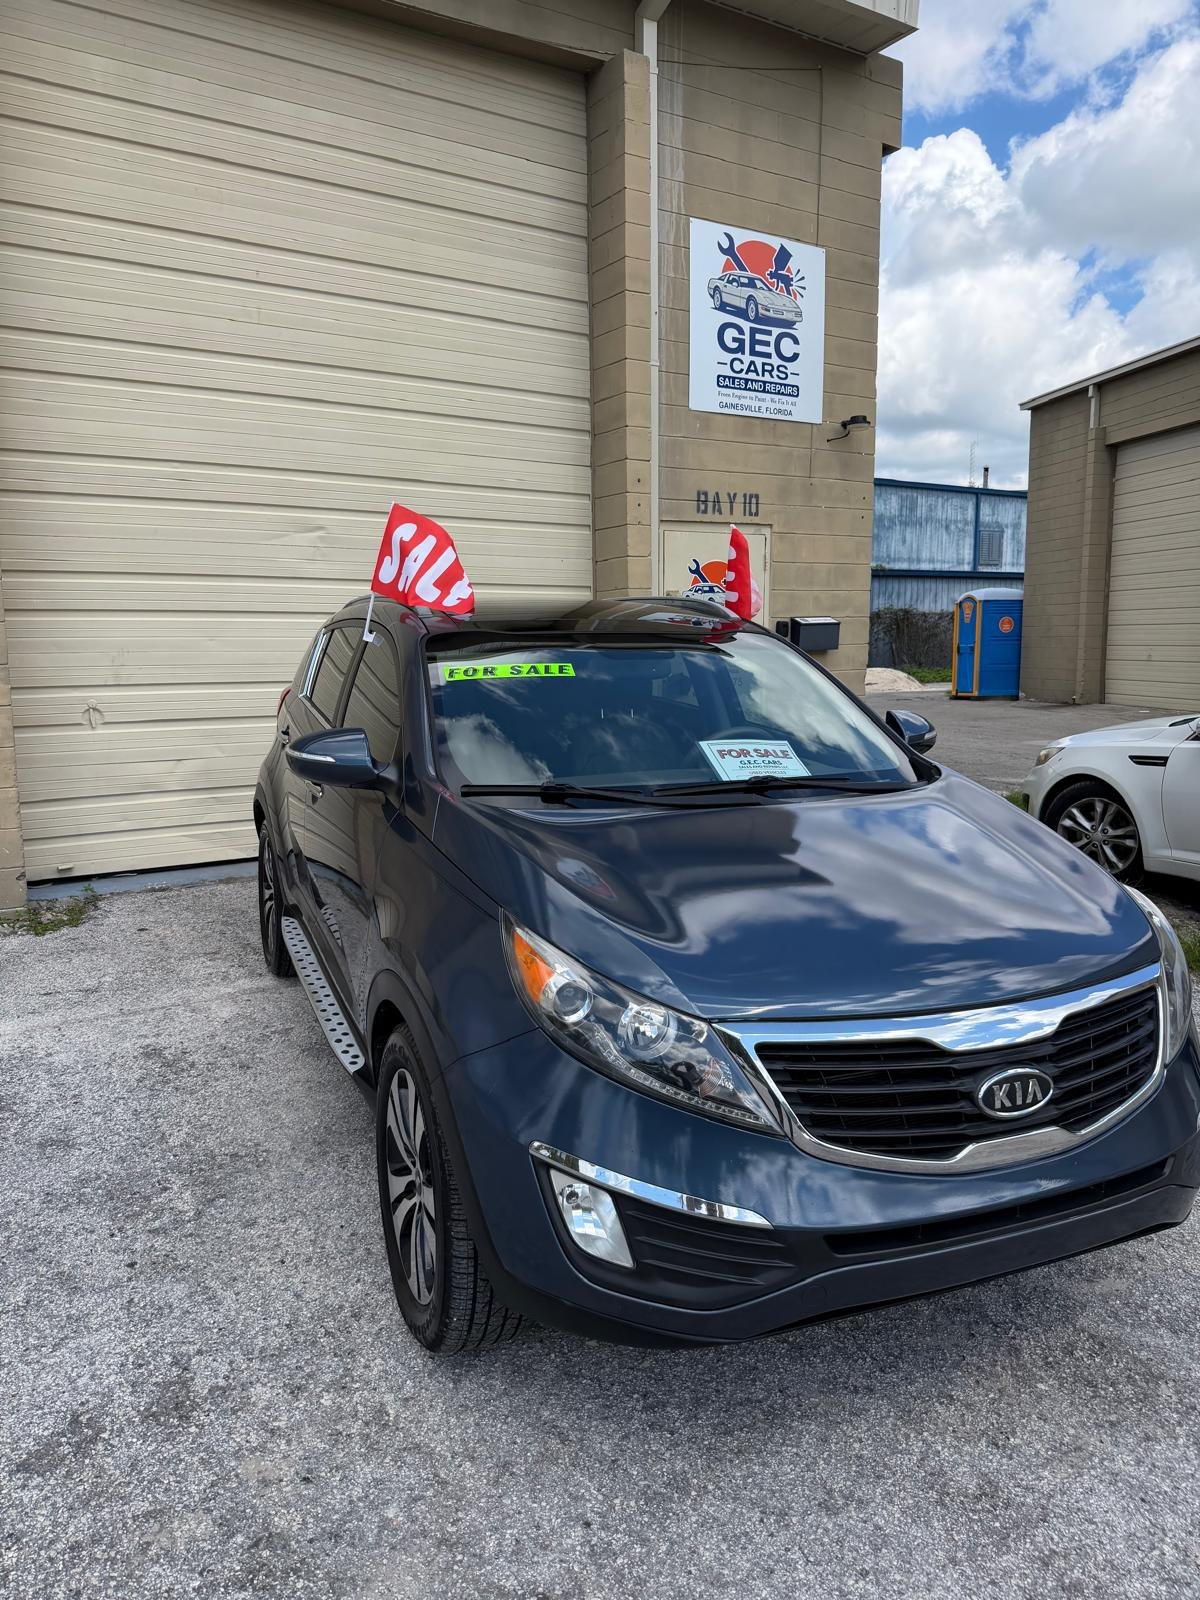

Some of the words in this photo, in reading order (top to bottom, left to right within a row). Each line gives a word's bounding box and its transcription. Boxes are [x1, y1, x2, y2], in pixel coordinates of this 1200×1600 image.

[717, 321, 800, 363] GEC
[718, 376, 746, 389] SALES
[746, 380, 764, 391] AND
[765, 383, 798, 396] REPAIRS
[717, 390, 731, 398] From
[731, 392, 748, 401] Engine
[718, 401, 764, 415] GAINESVILLE,
[765, 406, 793, 417] FLORIDA
[696, 490, 737, 515] BAY
[743, 492, 760, 517] 10
[447, 665, 497, 679] FOR
[509, 664, 572, 675] SALE
[716, 748, 754, 760] FOR
[752, 748, 793, 760] SALE
[992, 1079, 1044, 1109] KIA
